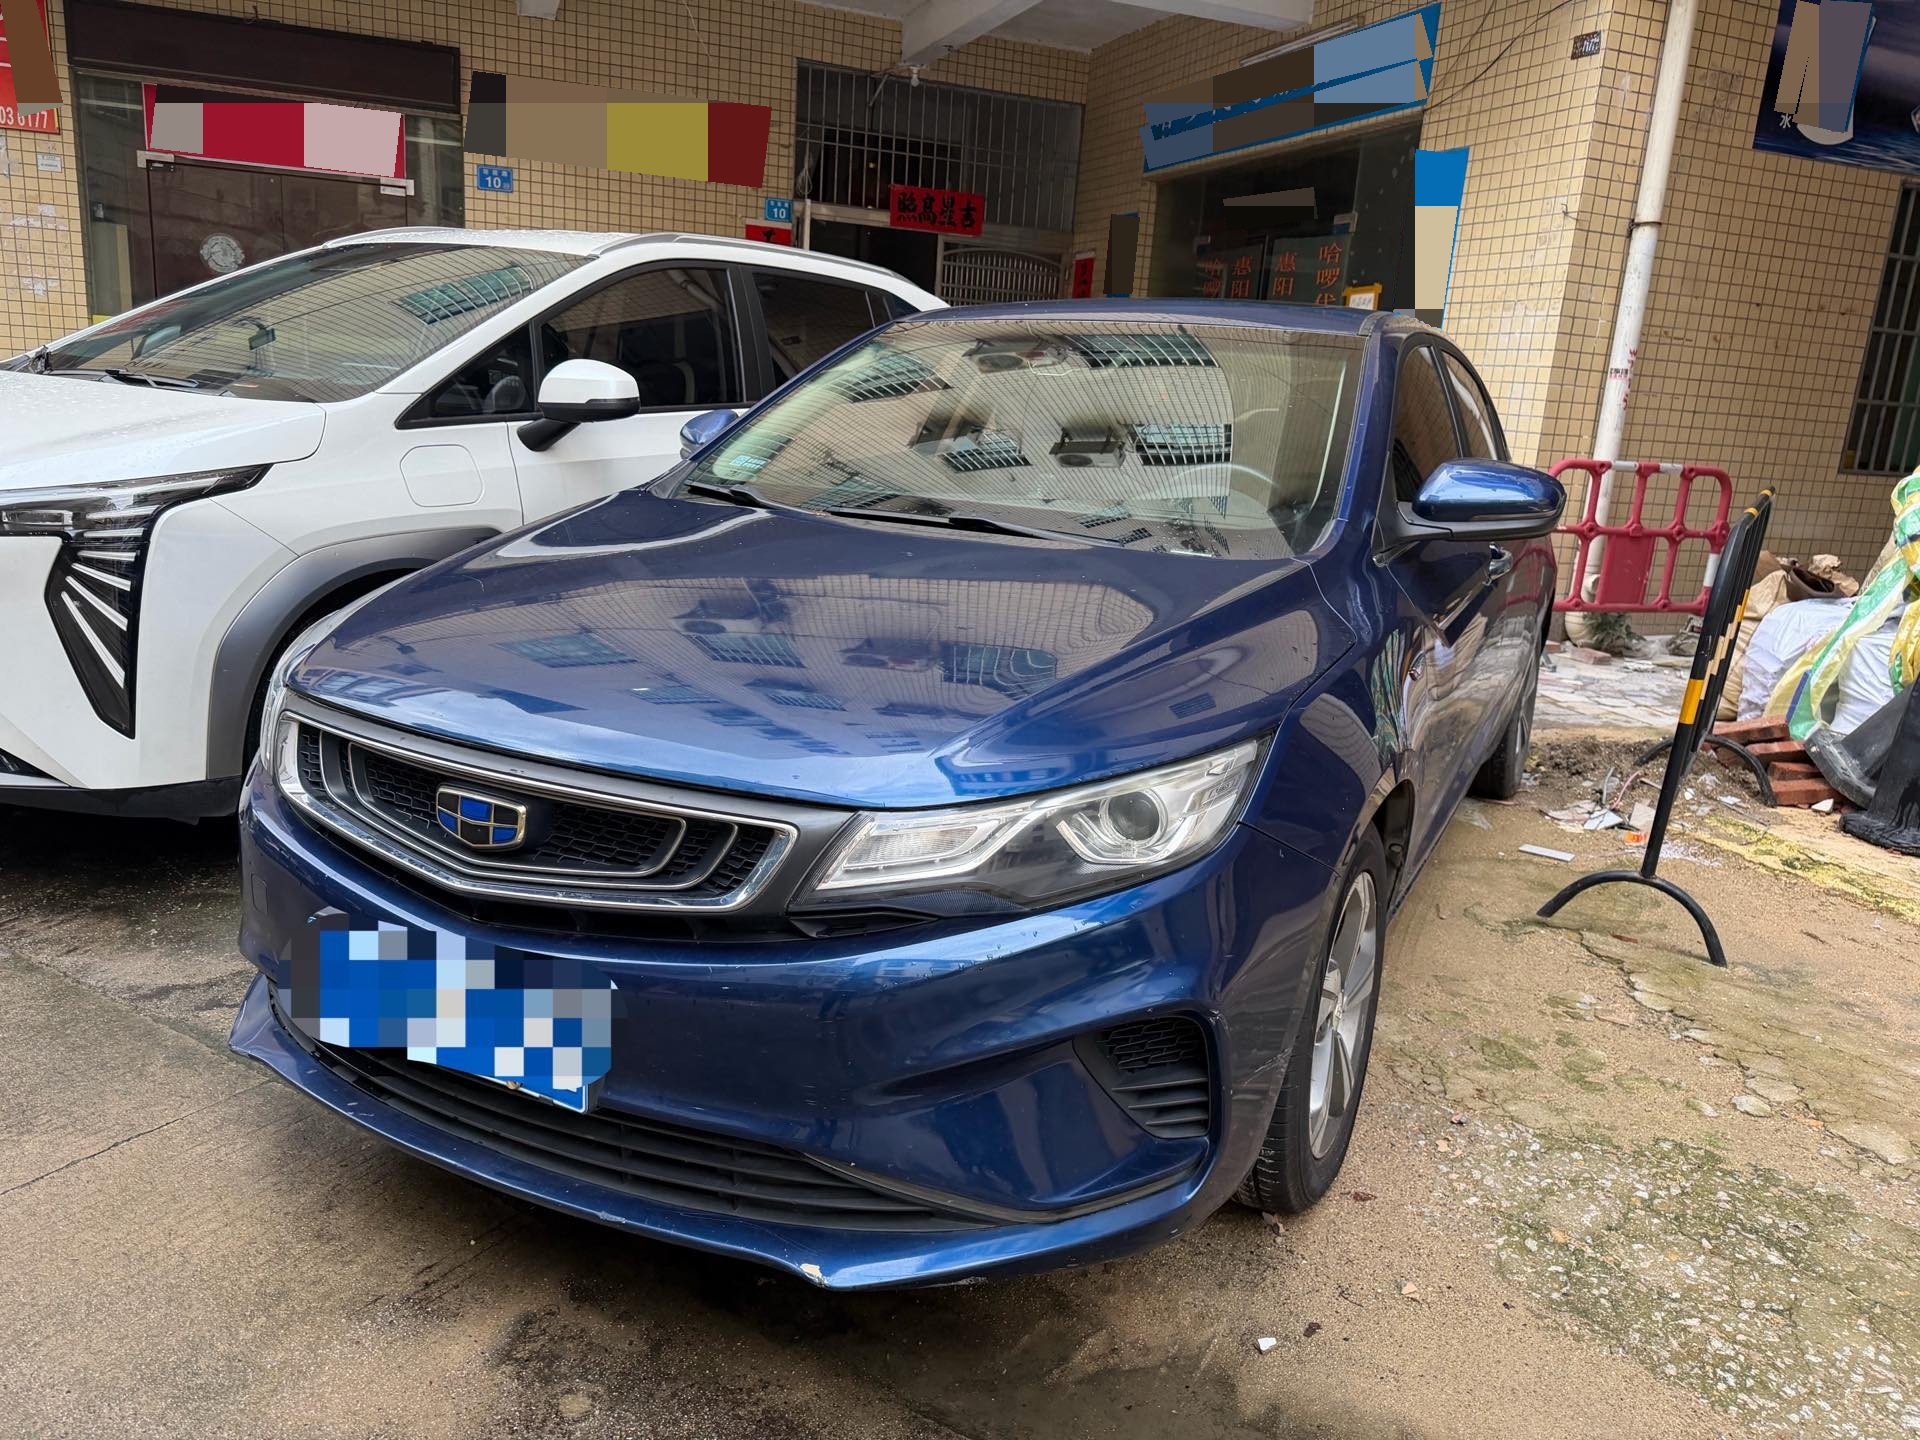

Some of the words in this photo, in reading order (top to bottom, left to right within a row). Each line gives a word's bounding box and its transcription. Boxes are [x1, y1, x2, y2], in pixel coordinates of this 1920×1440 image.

[1779, 113, 1791, 128] 水
[485, 176, 501, 189] 10
[773, 208, 786, 219] 10
